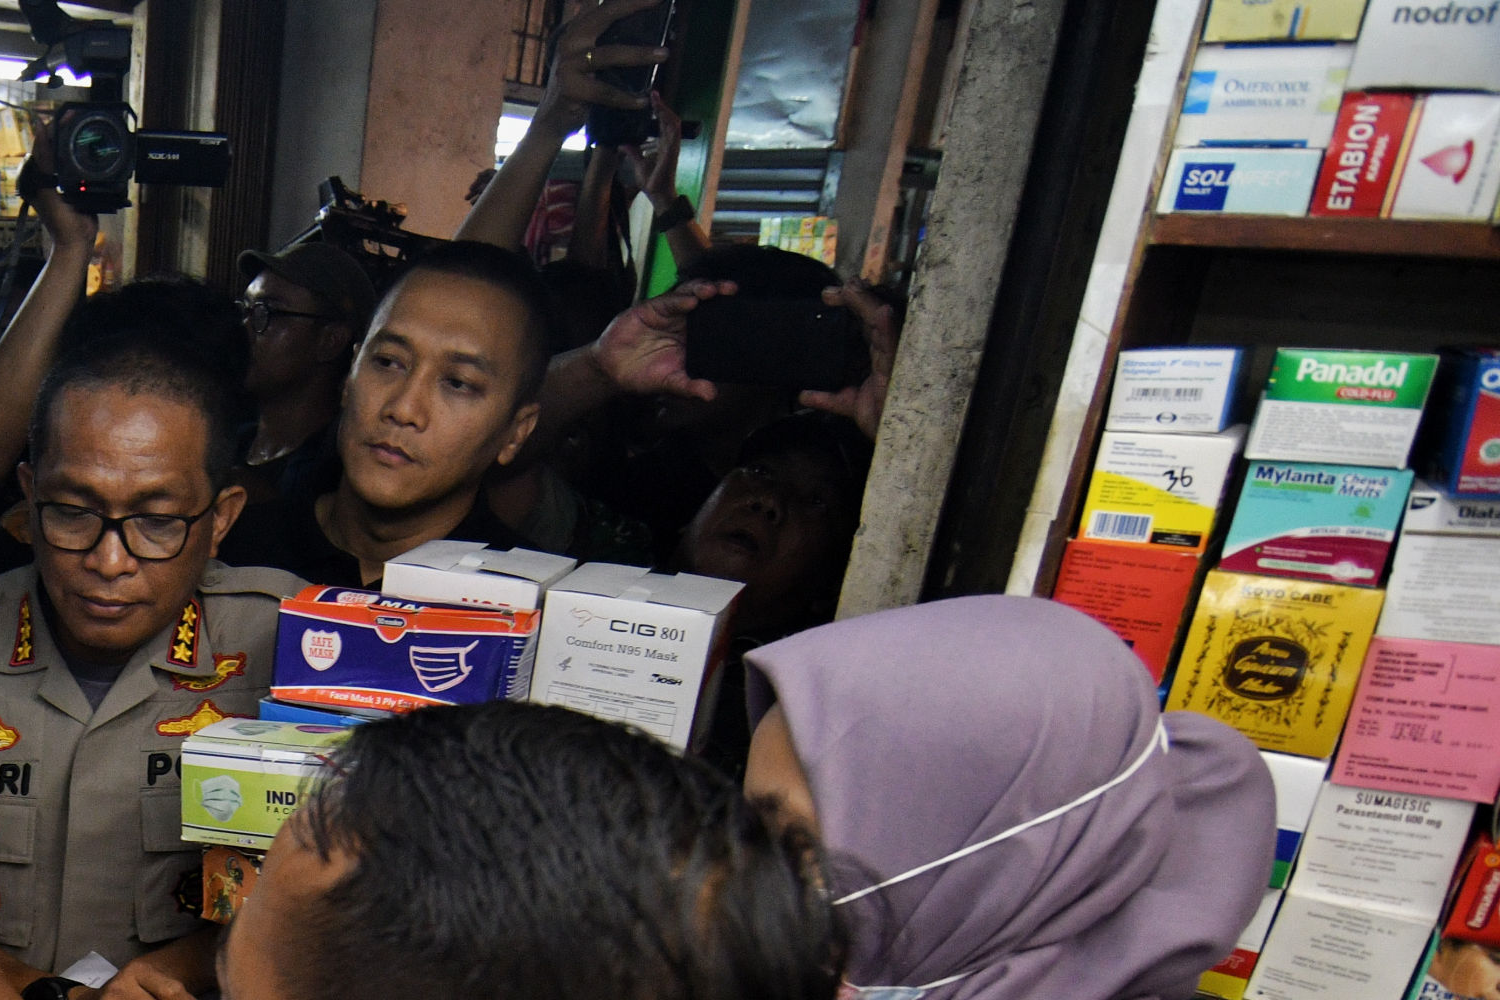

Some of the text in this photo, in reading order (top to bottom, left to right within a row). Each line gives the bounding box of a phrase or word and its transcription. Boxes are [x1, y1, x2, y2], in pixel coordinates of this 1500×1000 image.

[1392, 3, 1499, 25] nodrof
[1326, 103, 1381, 210] ETABION
[1296, 357, 1409, 388] Panadol
[1254, 465, 1336, 487] Mylanta
[1338, 485, 1382, 499] Melts
[609, 619, 686, 643] CIG 801
[310, 636, 333, 648] SAFE
[565, 635, 679, 663] Comfort N95 Mask
[308, 647, 335, 660] MASK
[329, 690, 350, 701] Face
[350, 692, 374, 705] Mask
[383, 696, 397, 708] Ply
[1355, 792, 1432, 813] SUMAGESIC
[1427, 818, 1443, 829] mg
